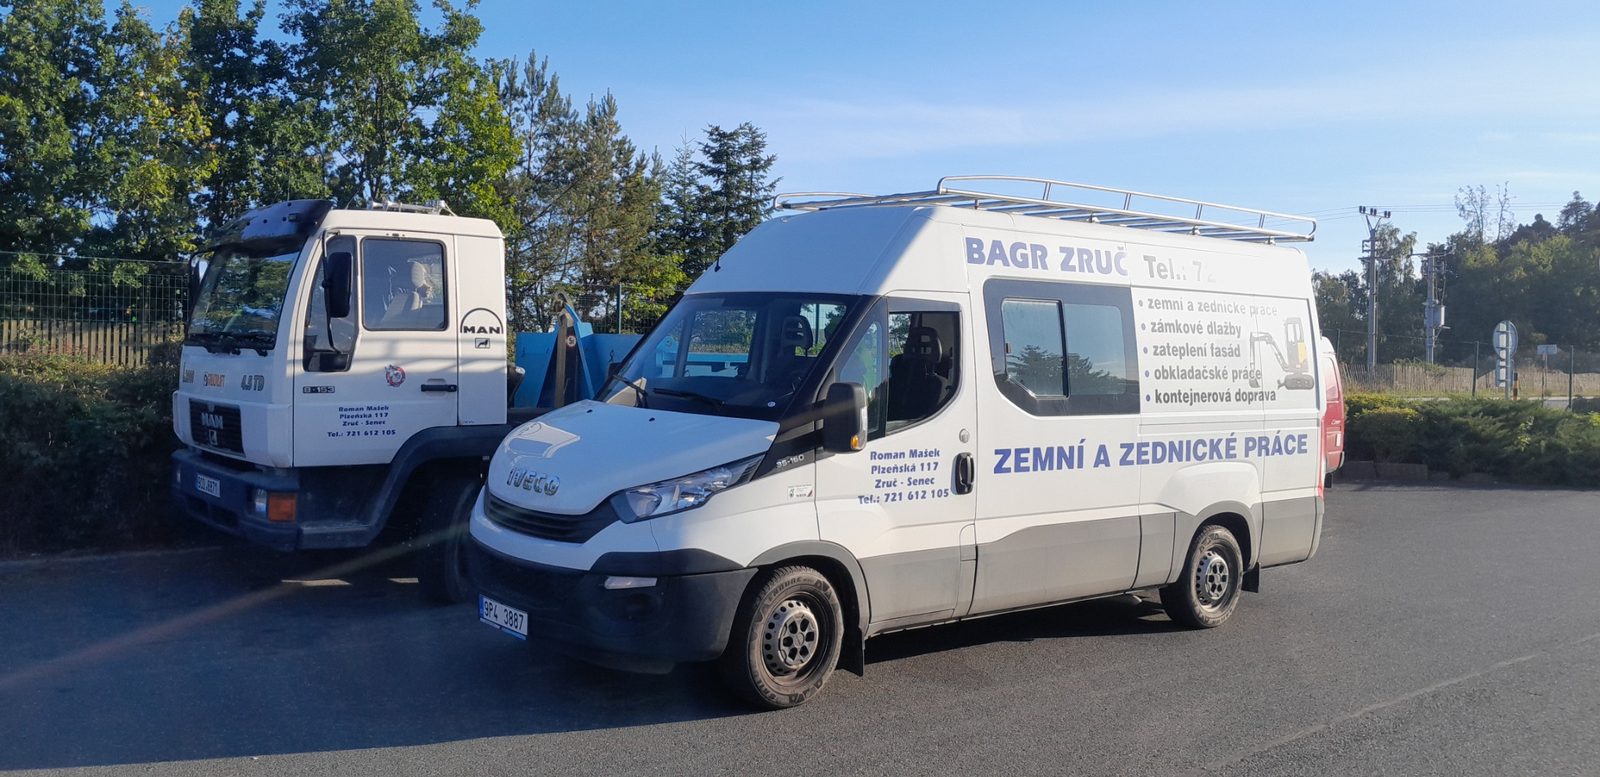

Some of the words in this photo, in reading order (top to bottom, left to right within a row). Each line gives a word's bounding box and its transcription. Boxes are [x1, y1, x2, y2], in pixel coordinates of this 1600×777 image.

[965, 237, 1049, 271] BAGR
[1059, 246, 1129, 277] ZRUČ
[1187, 300, 1195, 312] a
[463, 325, 500, 334] MAN
[1150, 319, 1204, 335] zámkové
[1207, 321, 1242, 338] dlažby
[1152, 342, 1208, 359] zateplení
[1210, 343, 1241, 358] fasád
[1154, 365, 1229, 381] obkladačské
[1231, 366, 1263, 382] práce
[1155, 388, 1232, 406] kontejnerová
[1234, 389, 1277, 404] doprava
[201, 412, 223, 430] MAN
[870, 450, 905, 461] Roman
[909, 448, 940, 459] Mašek
[993, 438, 1086, 474] ZEMNÍ
[1093, 443, 1111, 469] A
[1119, 432, 1237, 466] ZEDNICKÉ
[1244, 430, 1308, 457] PRÁCE
[776, 454, 805, 468] 35-160
[871, 463, 916, 475] Plzeňská
[920, 461, 939, 472] 117
[506, 467, 560, 497] IVECO
[874, 478, 898, 489] Zruč
[907, 476, 935, 487] Senec
[857, 494, 880, 505] Tel.:
[884, 491, 903, 503] 721
[907, 489, 927, 501] 612
[931, 488, 949, 499] 105
[484, 601, 498, 621] 9P4
[503, 608, 524, 631] 3887
